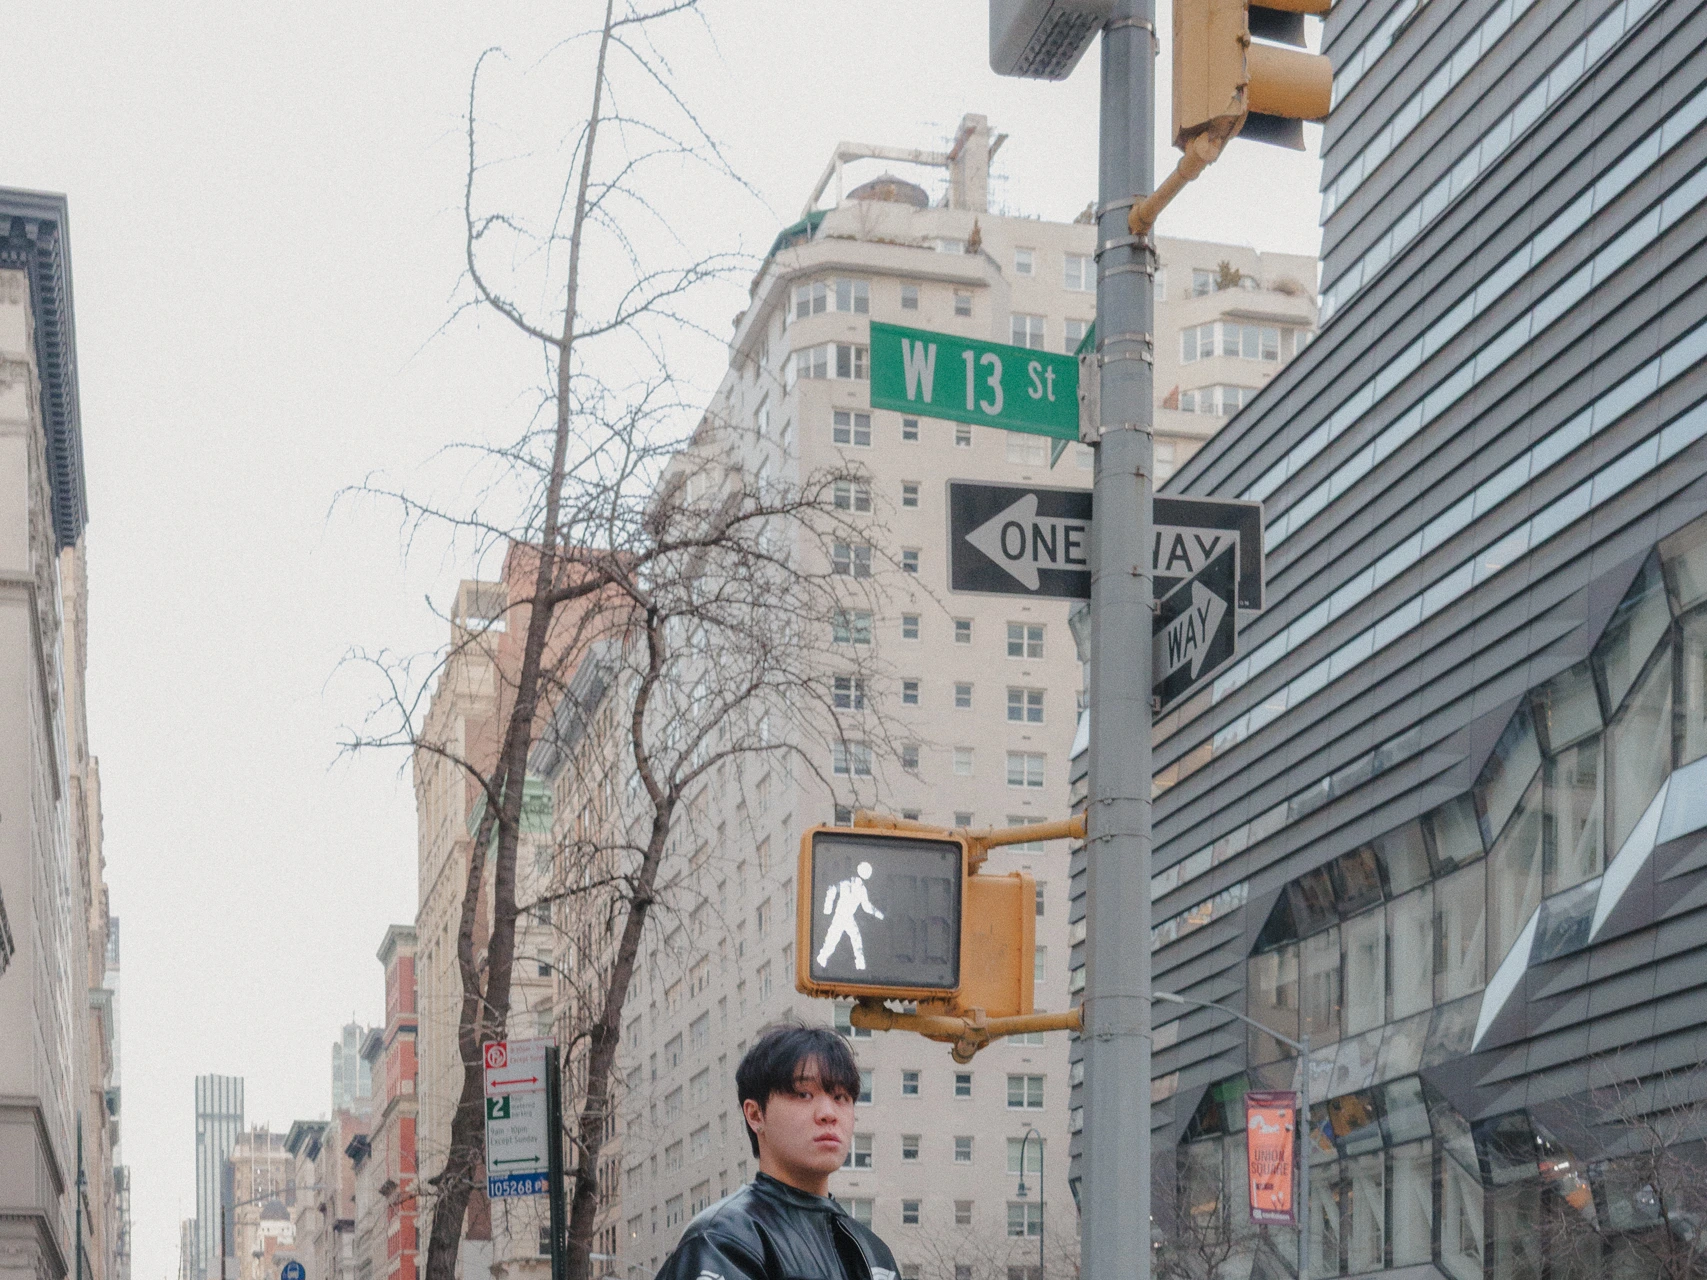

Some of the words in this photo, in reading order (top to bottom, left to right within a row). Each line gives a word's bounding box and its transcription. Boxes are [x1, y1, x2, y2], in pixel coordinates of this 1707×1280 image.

[901, 338, 937, 404] W
[961, 350, 1005, 417] 13
[1028, 361, 1056, 402] St
[1000, 520, 1086, 565] ONE
[1153, 530, 1221, 573] AY
[1168, 598, 1212, 668] WAY
[492, 1096, 504, 1118] 2
[491, 1136, 512, 1146] Except
[514, 1135, 537, 1144] Sunday
[1254, 1148, 1285, 1162] UNION
[1250, 1162, 1289, 1176] SQUARE
[491, 1179, 533, 1197] 105268
